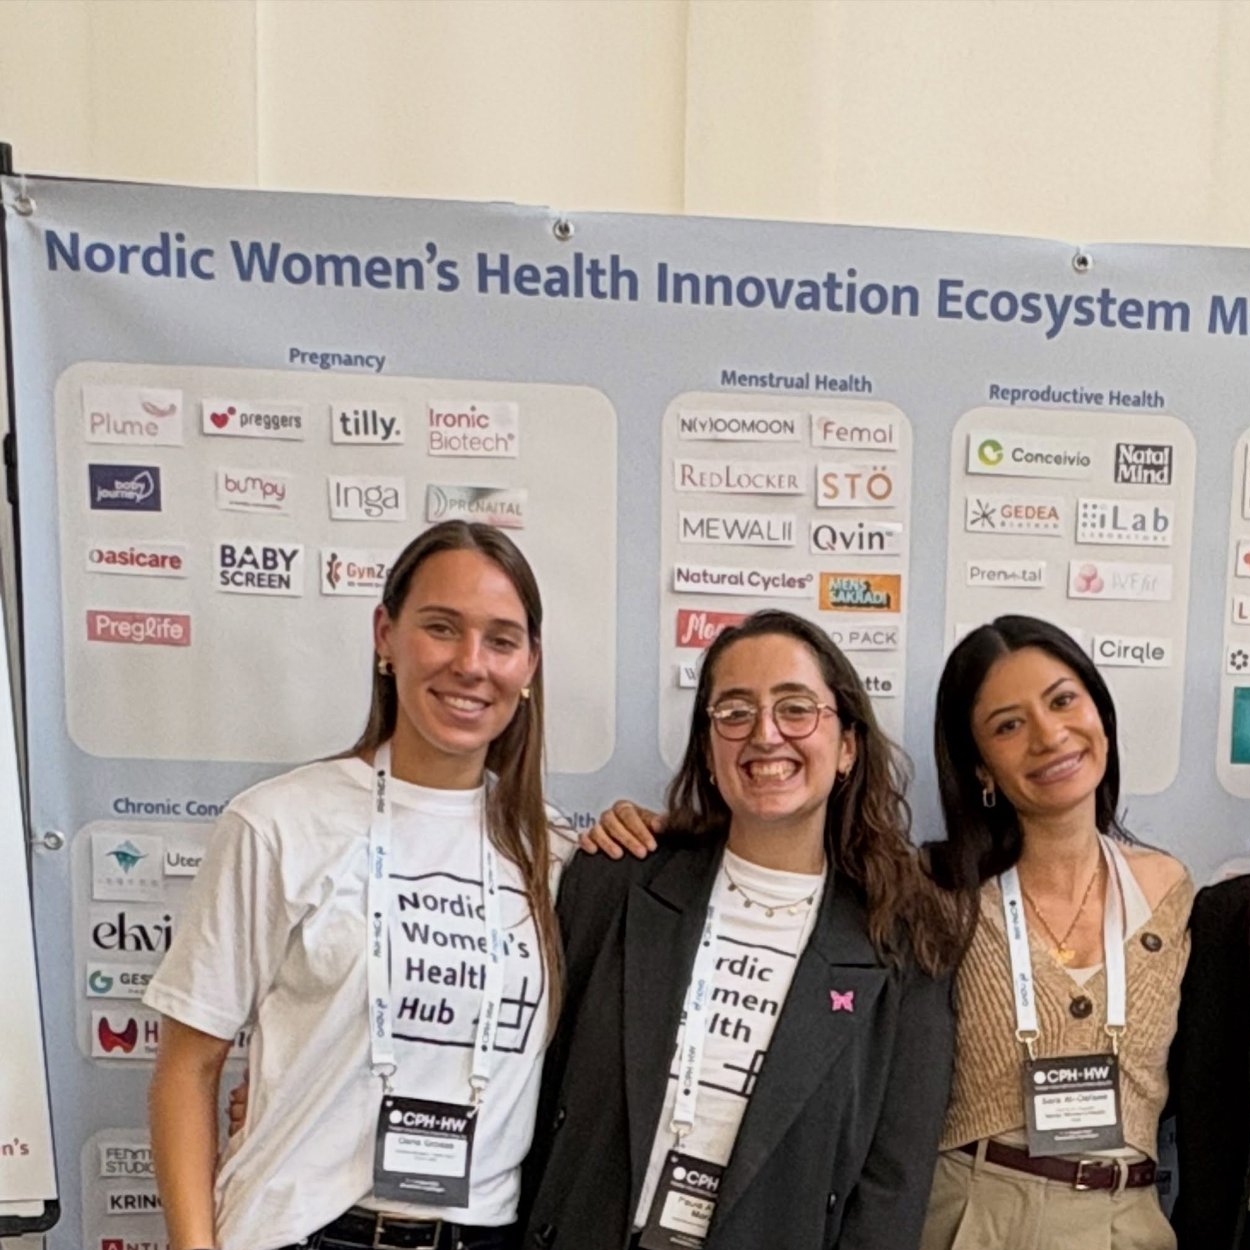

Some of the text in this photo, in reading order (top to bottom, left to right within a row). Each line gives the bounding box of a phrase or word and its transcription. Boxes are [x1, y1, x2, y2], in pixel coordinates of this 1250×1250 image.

[44, 229, 216, 281] Nordic
[230, 240, 461, 293] Women's
[477, 252, 640, 302] Health
[657, 262, 920, 317] Innovation
[937, 279, 1191, 339] Ecosystem
[288, 347, 386, 373] Pregnancy
[720, 370, 873, 393] Menstrual Health
[989, 384, 1165, 409] Reproductive Health
[90, 411, 159, 437] Plume
[239, 411, 302, 431] preggers
[339, 409, 401, 441] tilly.
[429, 405, 490, 429] Ironic
[1011, 447, 1091, 468] Conceivio
[1118, 445, 1170, 465] Natal
[1117, 464, 1169, 484] Mind
[335, 481, 400, 518] Inga
[1001, 503, 1060, 521] GEDEA
[812, 522, 885, 551] Qvin
[220, 544, 300, 572] BABY
[220, 570, 291, 589] SCREEN
[676, 567, 744, 586] Natural
[95, 614, 184, 642] Preglife
[849, 631, 898, 645] PACK
[1099, 640, 1165, 663] Cirqle
[113, 797, 181, 816] Chronic
[715, 954, 774, 983] rdic
[396, 996, 456, 1026] Hub
[708, 1012, 752, 1044] lth
[0, 1137, 30, 1156] n's
